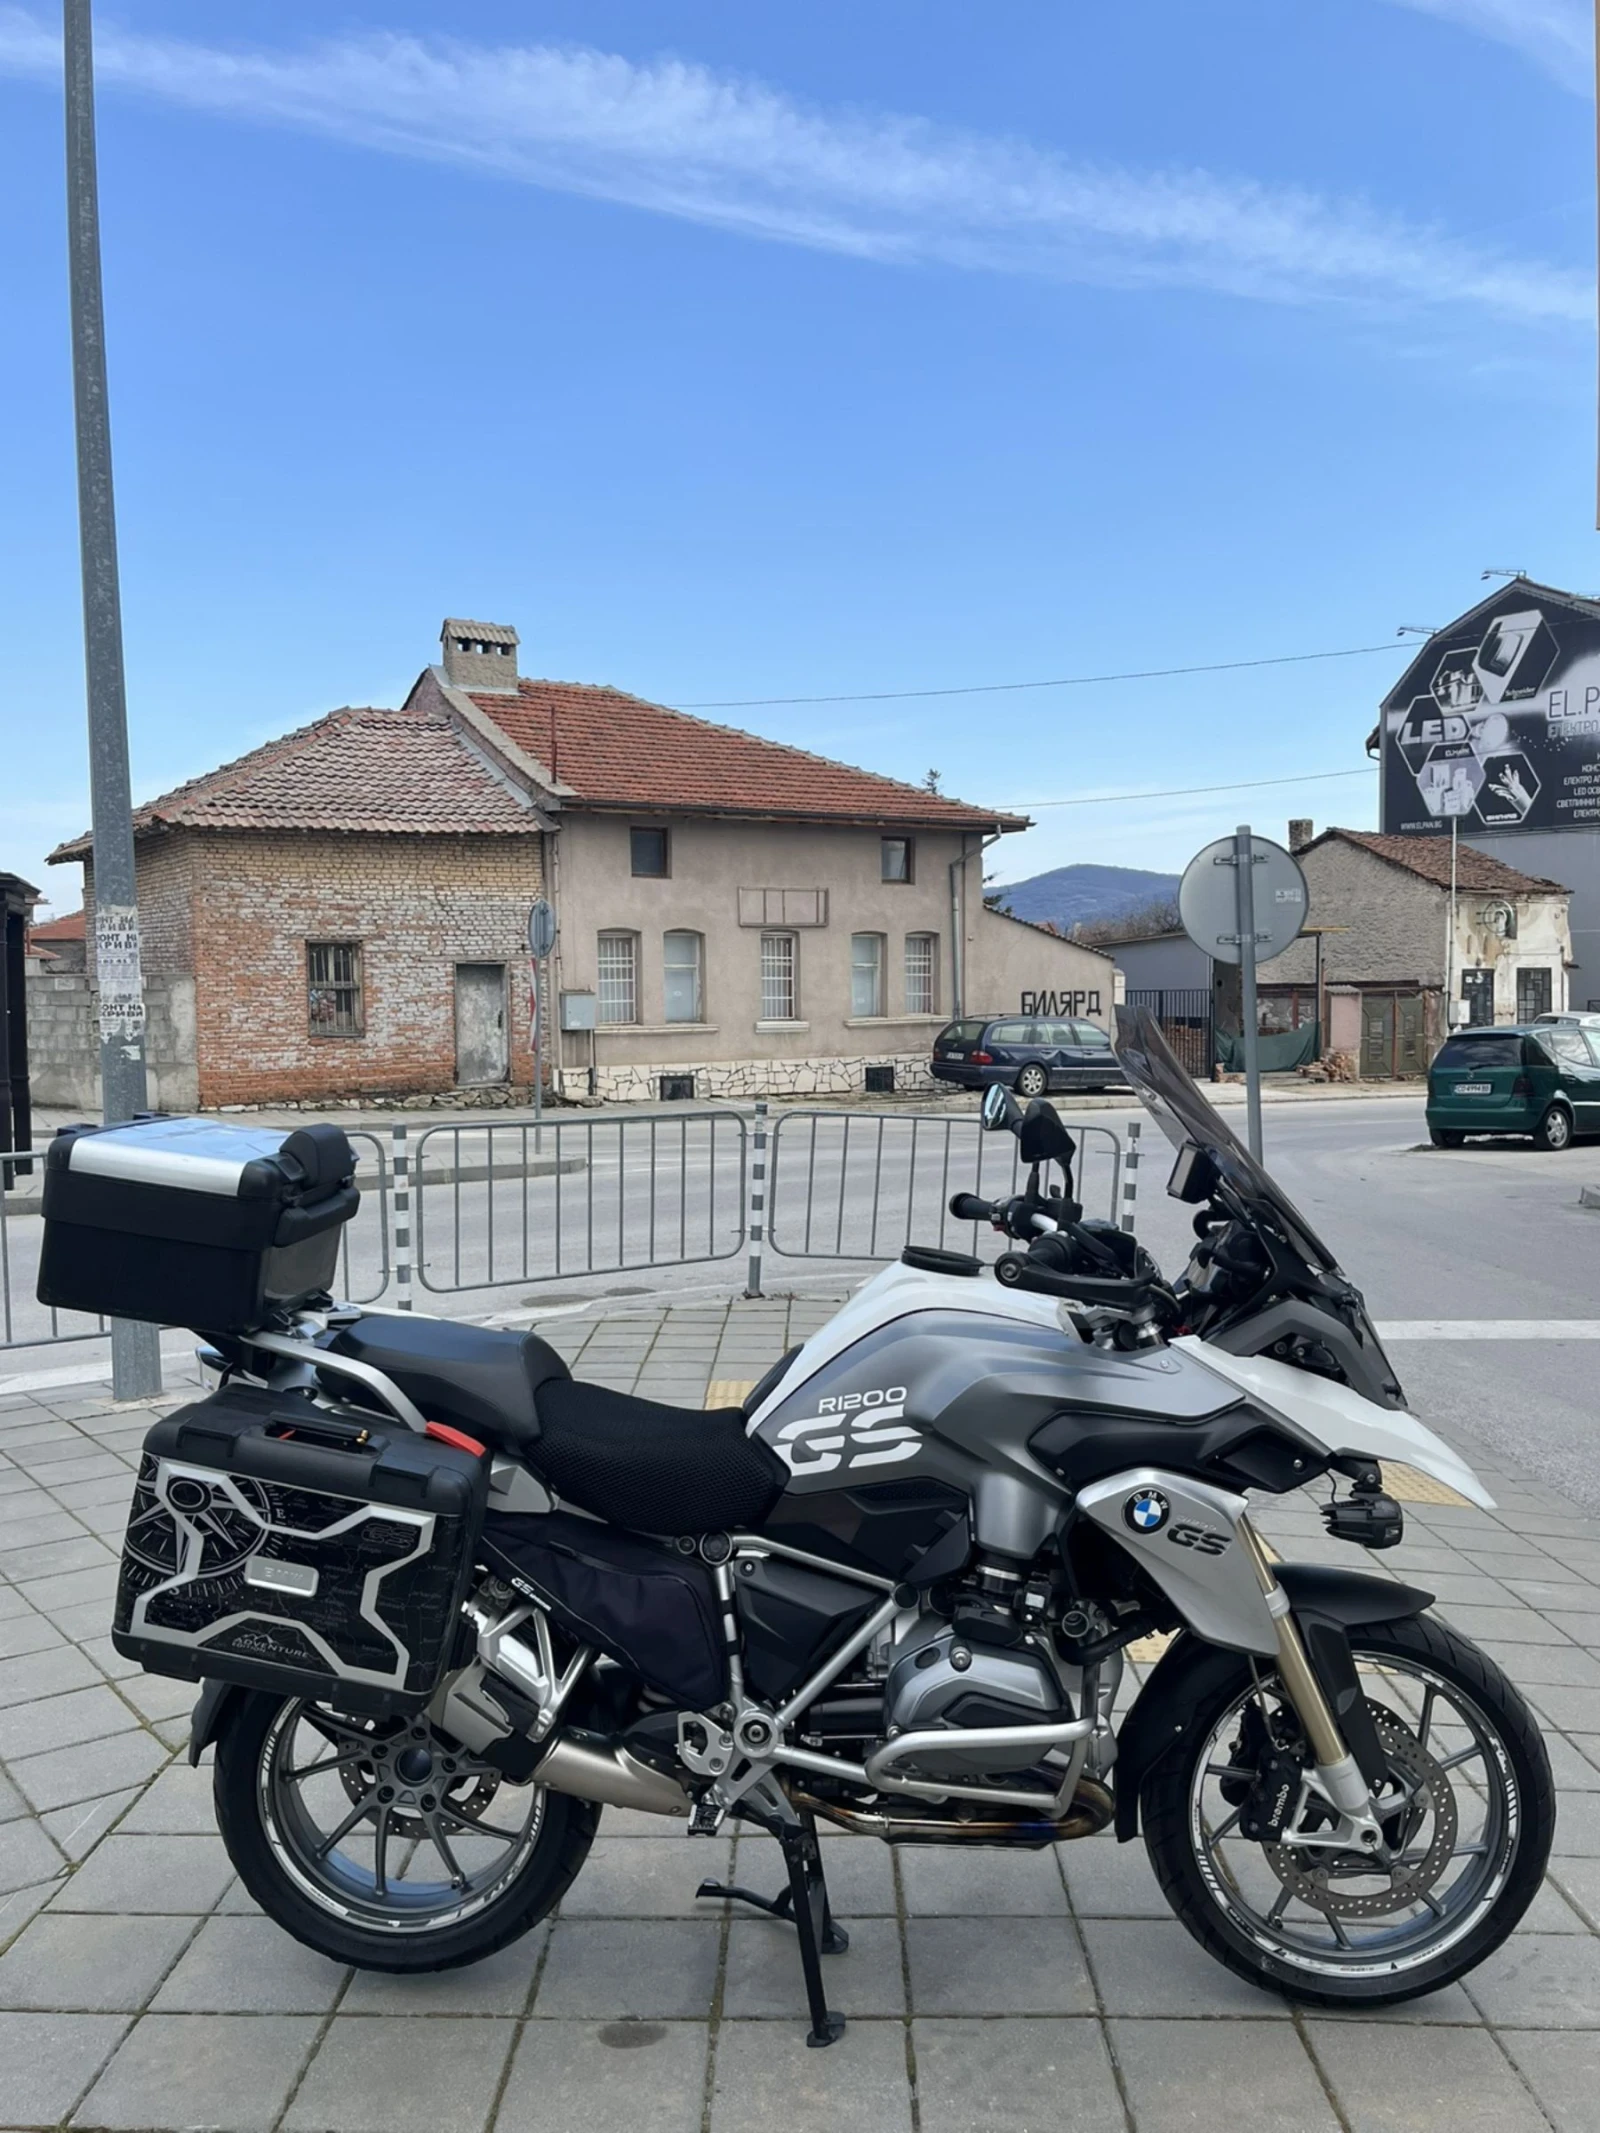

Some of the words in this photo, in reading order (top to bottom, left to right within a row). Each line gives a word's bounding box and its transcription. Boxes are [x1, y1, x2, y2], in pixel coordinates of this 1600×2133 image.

[1549, 686, 1600, 718] EL.P
[1401, 717, 1467, 744] LED
[1021, 990, 1102, 1017] БИЛЯРД
[818, 1386, 907, 1414] R1200
[772, 1404, 923, 1477] GS
[1133, 1491, 1169, 1510] BMW
[1167, 1524, 1232, 1556] GS
[511, 1577, 535, 1595] GS
[232, 1637, 309, 1658] ADVENTURE
[1267, 1783, 1290, 1827] brembo
